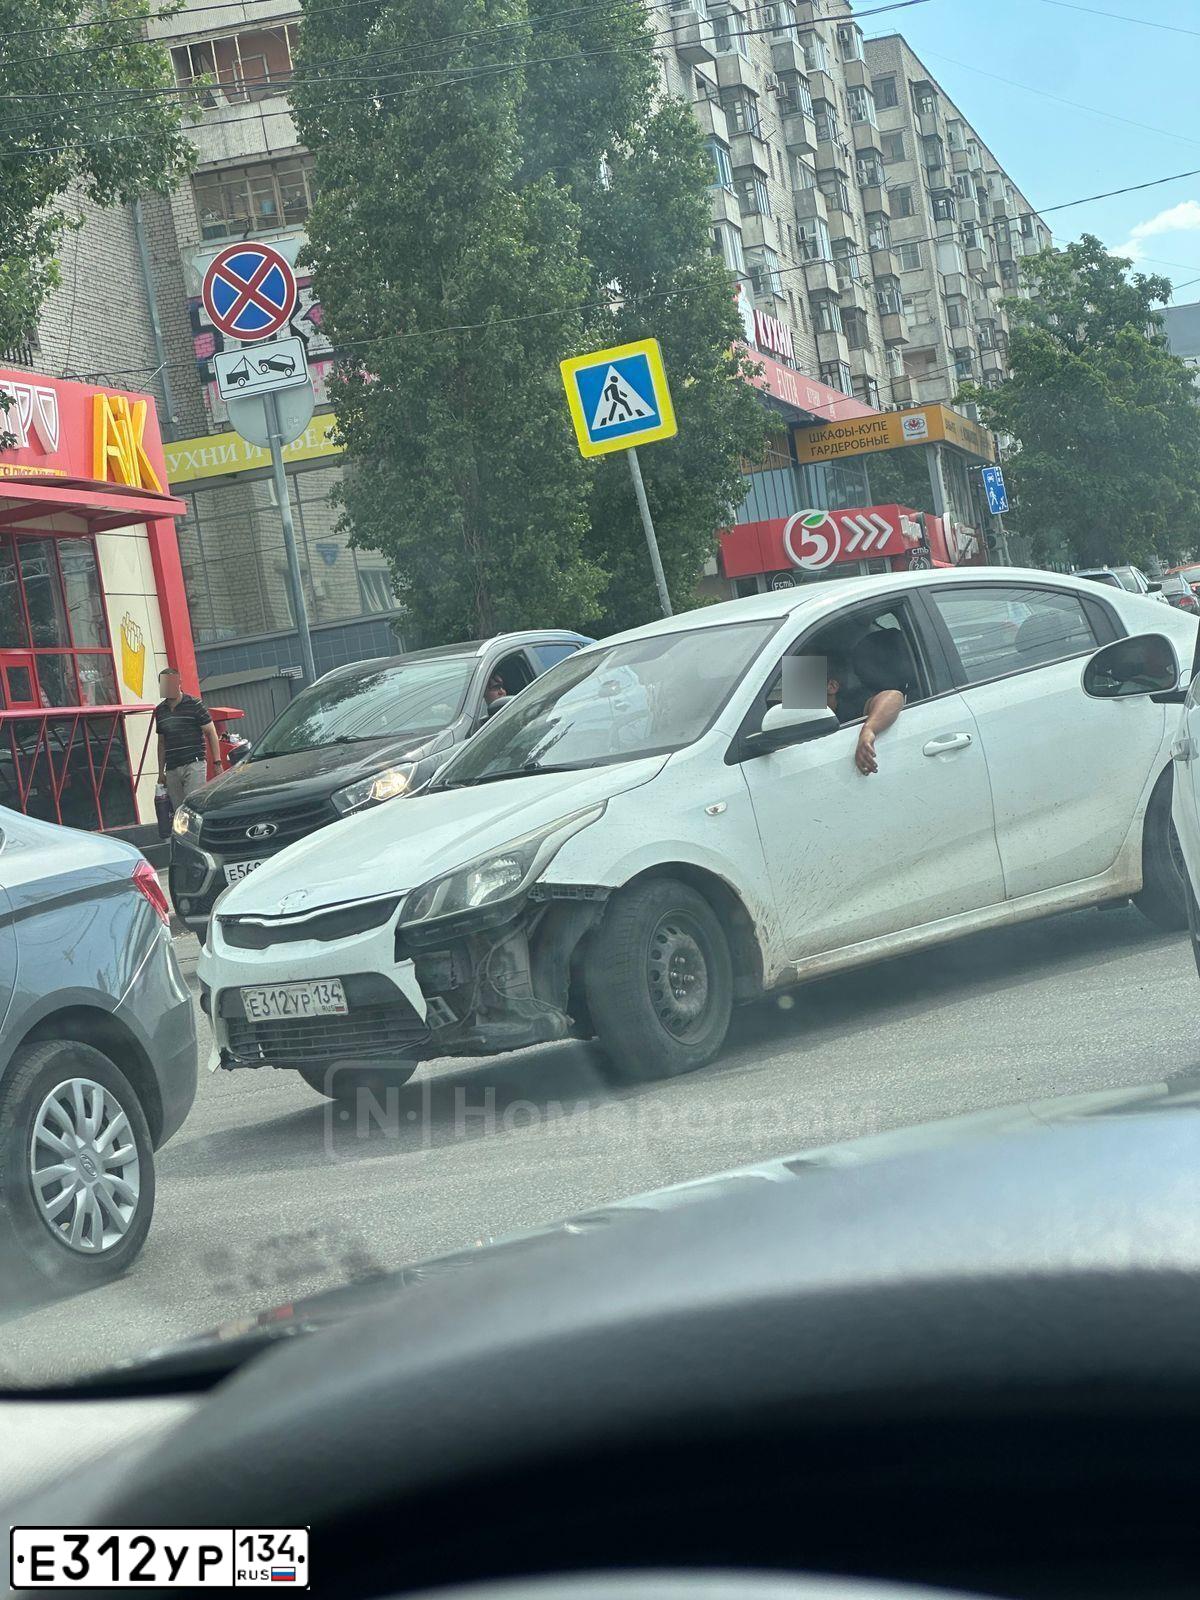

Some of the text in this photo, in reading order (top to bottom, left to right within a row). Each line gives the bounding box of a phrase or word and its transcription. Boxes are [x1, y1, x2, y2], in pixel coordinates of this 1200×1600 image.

[753, 308, 795, 360] КУХНИ
[808, 420, 888, 444] ШКАФЫ-КУПЕ
[810, 434, 890, 457] ГАРДЕРОБНЫЕ
[165, 441, 237, 474] УХНИ
[801, 527, 829, 563] 5
[249, 984, 342, 1018] Е312УР 134
